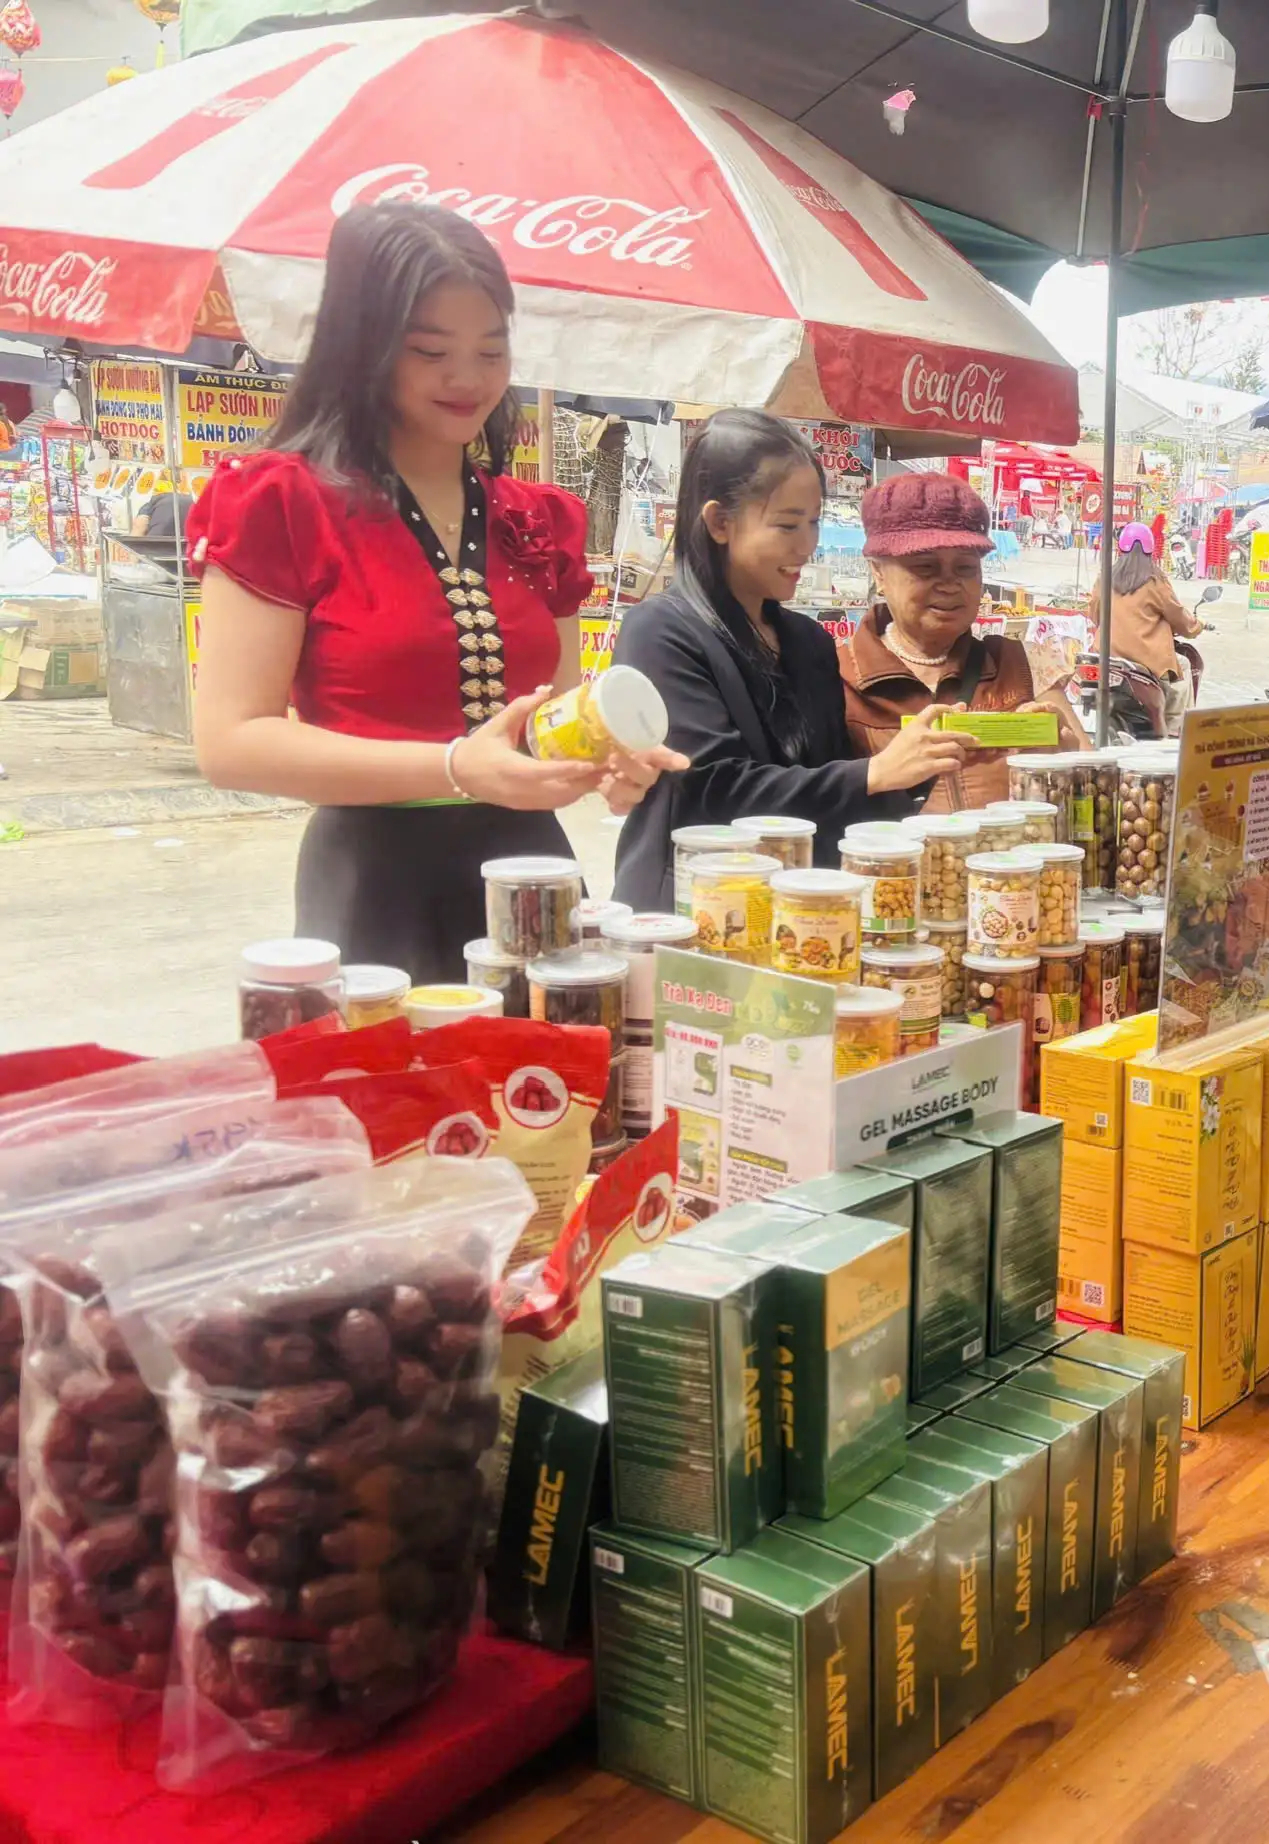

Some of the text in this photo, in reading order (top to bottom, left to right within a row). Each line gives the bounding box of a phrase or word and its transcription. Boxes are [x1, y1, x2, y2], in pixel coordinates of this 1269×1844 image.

[100, 421, 160, 439] HOTDOG
[902, 352, 1008, 427] Coca-Cola
[661, 980, 684, 1005] Trà
[859, 1119, 888, 1142] GEL
[891, 1092, 959, 1131] MASSAGE
[961, 1076, 999, 1105] BODY
[741, 1342, 763, 1478] LAMEC
[1153, 1413, 1170, 1523] LAMEC
[524, 1464, 566, 1587] LAMEC
[1061, 1478, 1077, 1595] LAMEC
[1109, 1444, 1127, 1570] LAMEC
[960, 1552, 978, 1679] LAMEC
[1015, 1514, 1034, 1637] LAMEC
[826, 1645, 850, 1782] LAMEC
[895, 1596, 919, 1728] LAMEC
